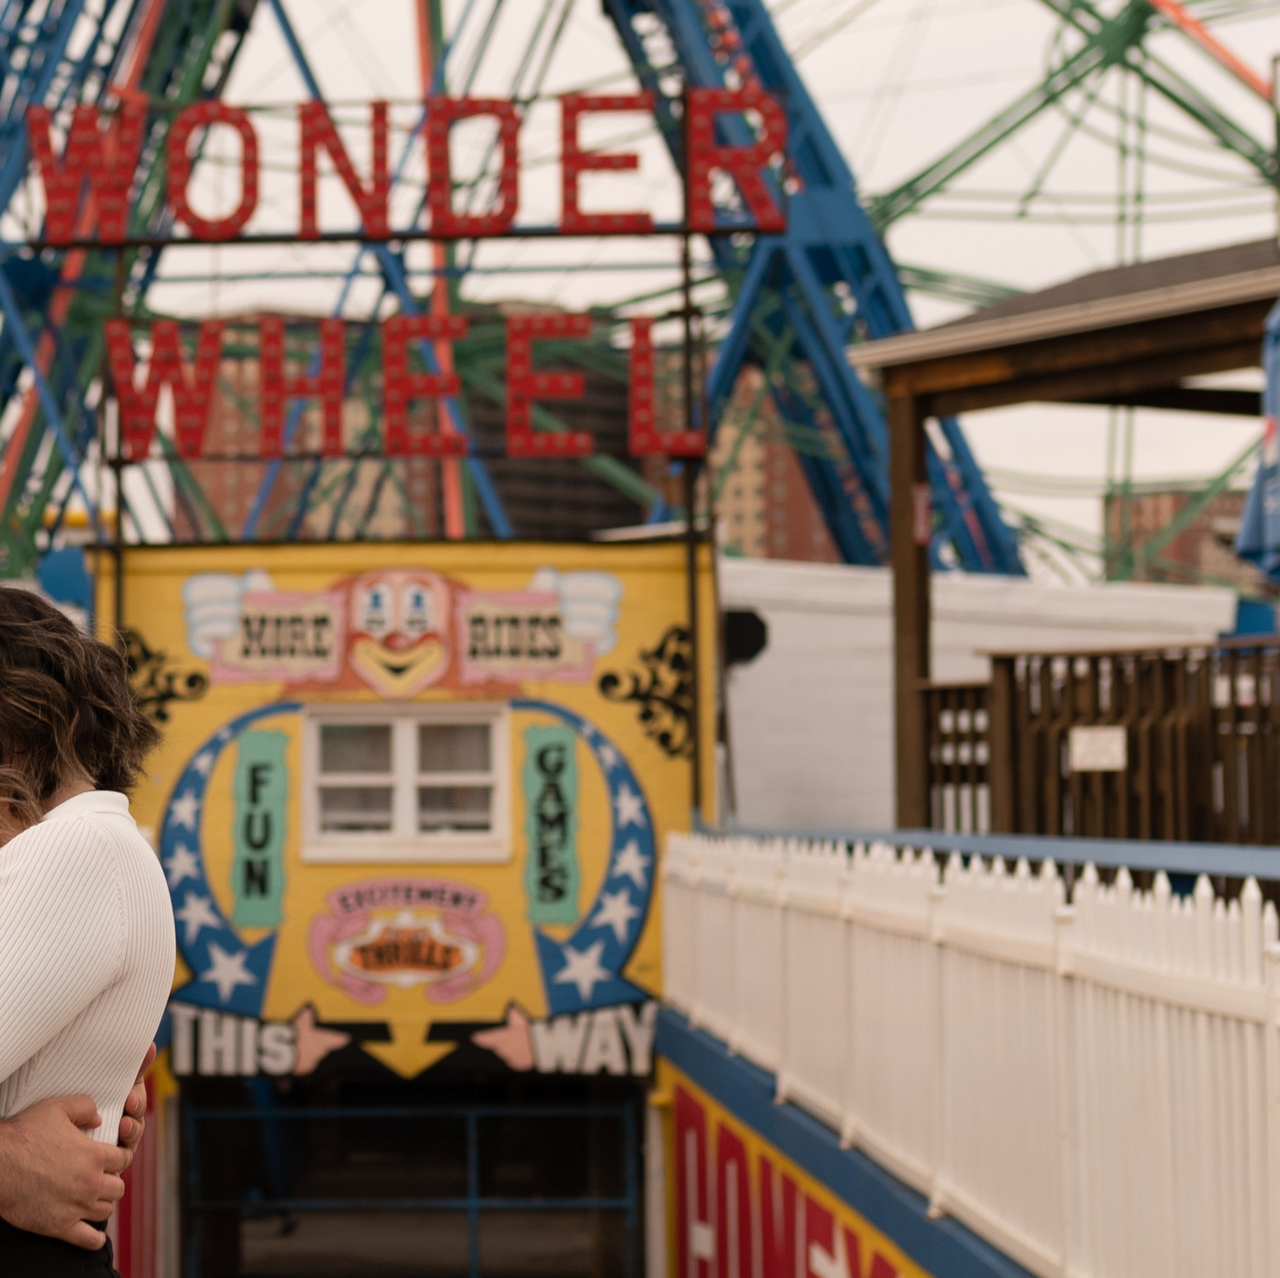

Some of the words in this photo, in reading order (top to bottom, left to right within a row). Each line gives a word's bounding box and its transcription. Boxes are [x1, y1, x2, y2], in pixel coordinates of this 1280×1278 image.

[26, 87, 790, 244] WONDER
[107, 316, 708, 458] WHEEL
[468, 614, 562, 659] RIDES
[244, 762, 273, 899] FUN
[537, 743, 569, 904] GAMES
[339, 885, 477, 912] EXCITEMENT
[169, 1003, 297, 1076] THIS
[533, 1002, 658, 1077] WAY
